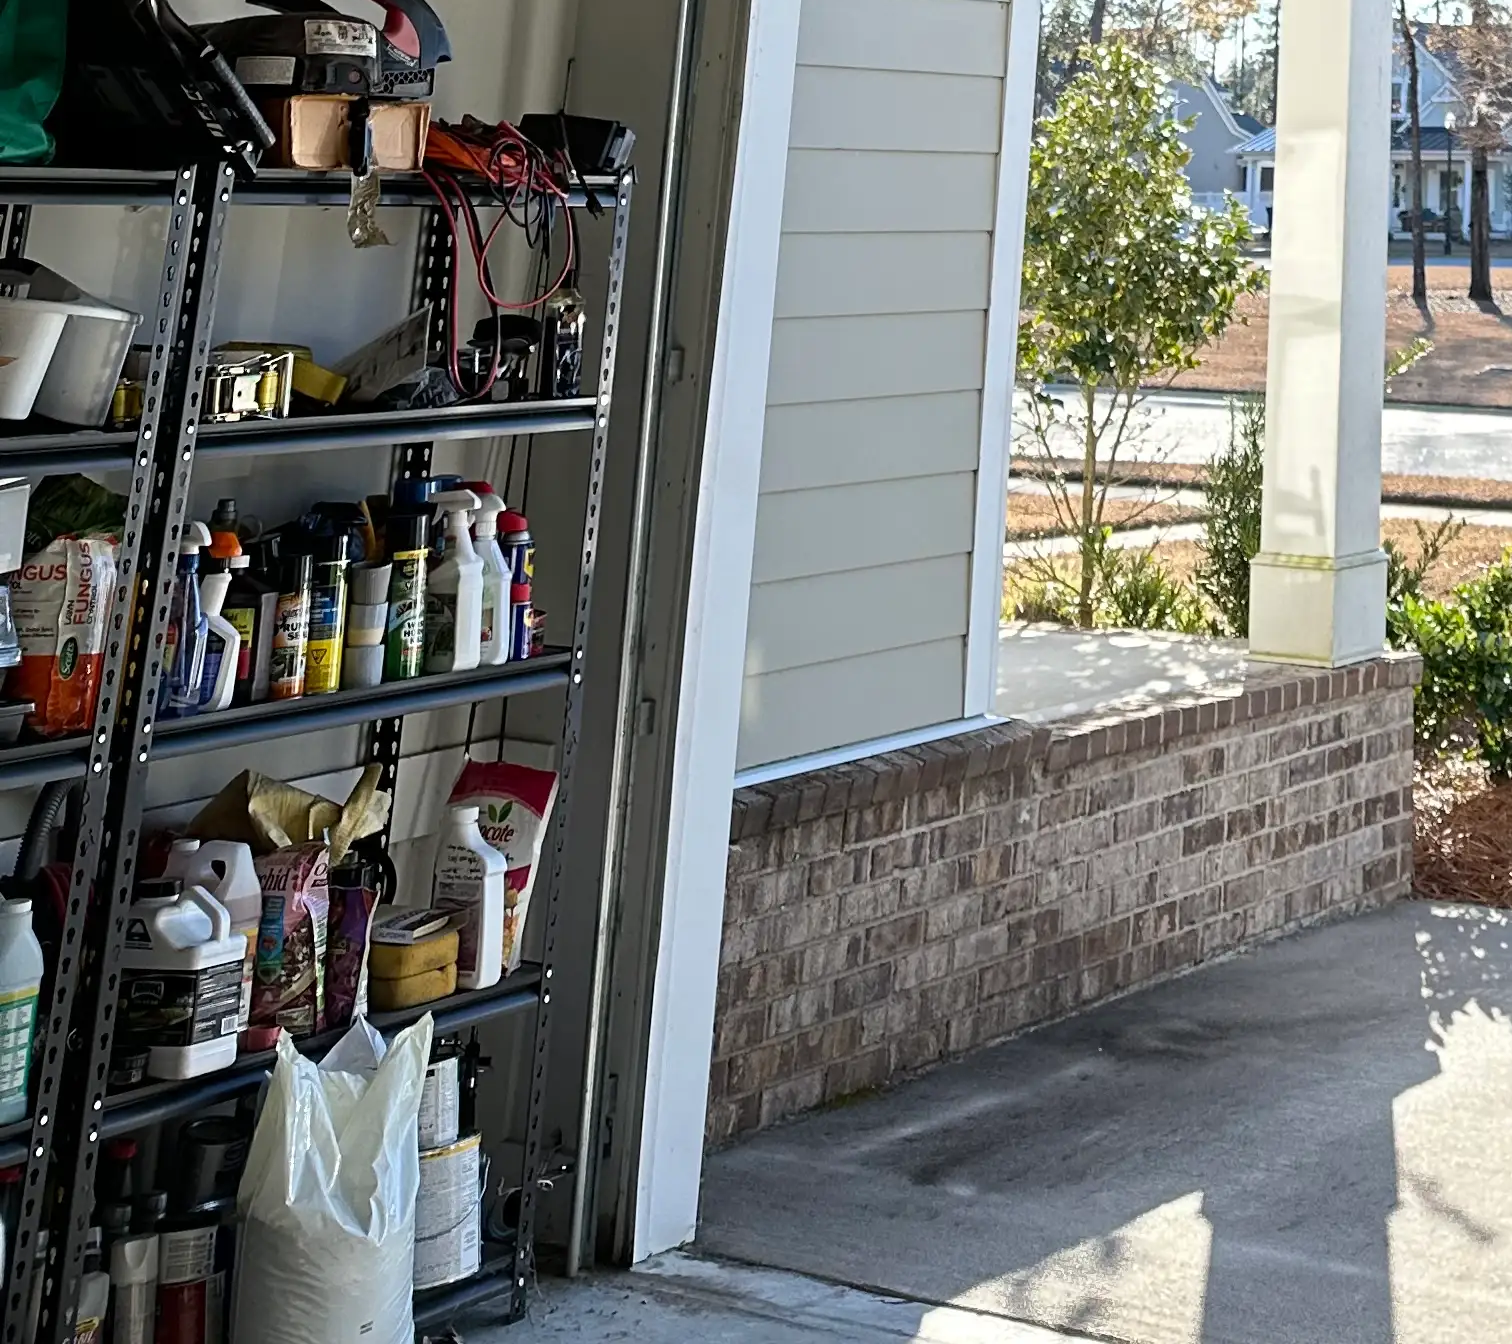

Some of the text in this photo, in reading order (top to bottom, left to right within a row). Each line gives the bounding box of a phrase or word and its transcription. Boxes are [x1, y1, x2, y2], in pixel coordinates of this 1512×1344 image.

[10, 564, 67, 581] NGUS
[74, 542, 92, 625] FUNGUS
[480, 823, 515, 842] ocote
[260, 867, 290, 892] chid
